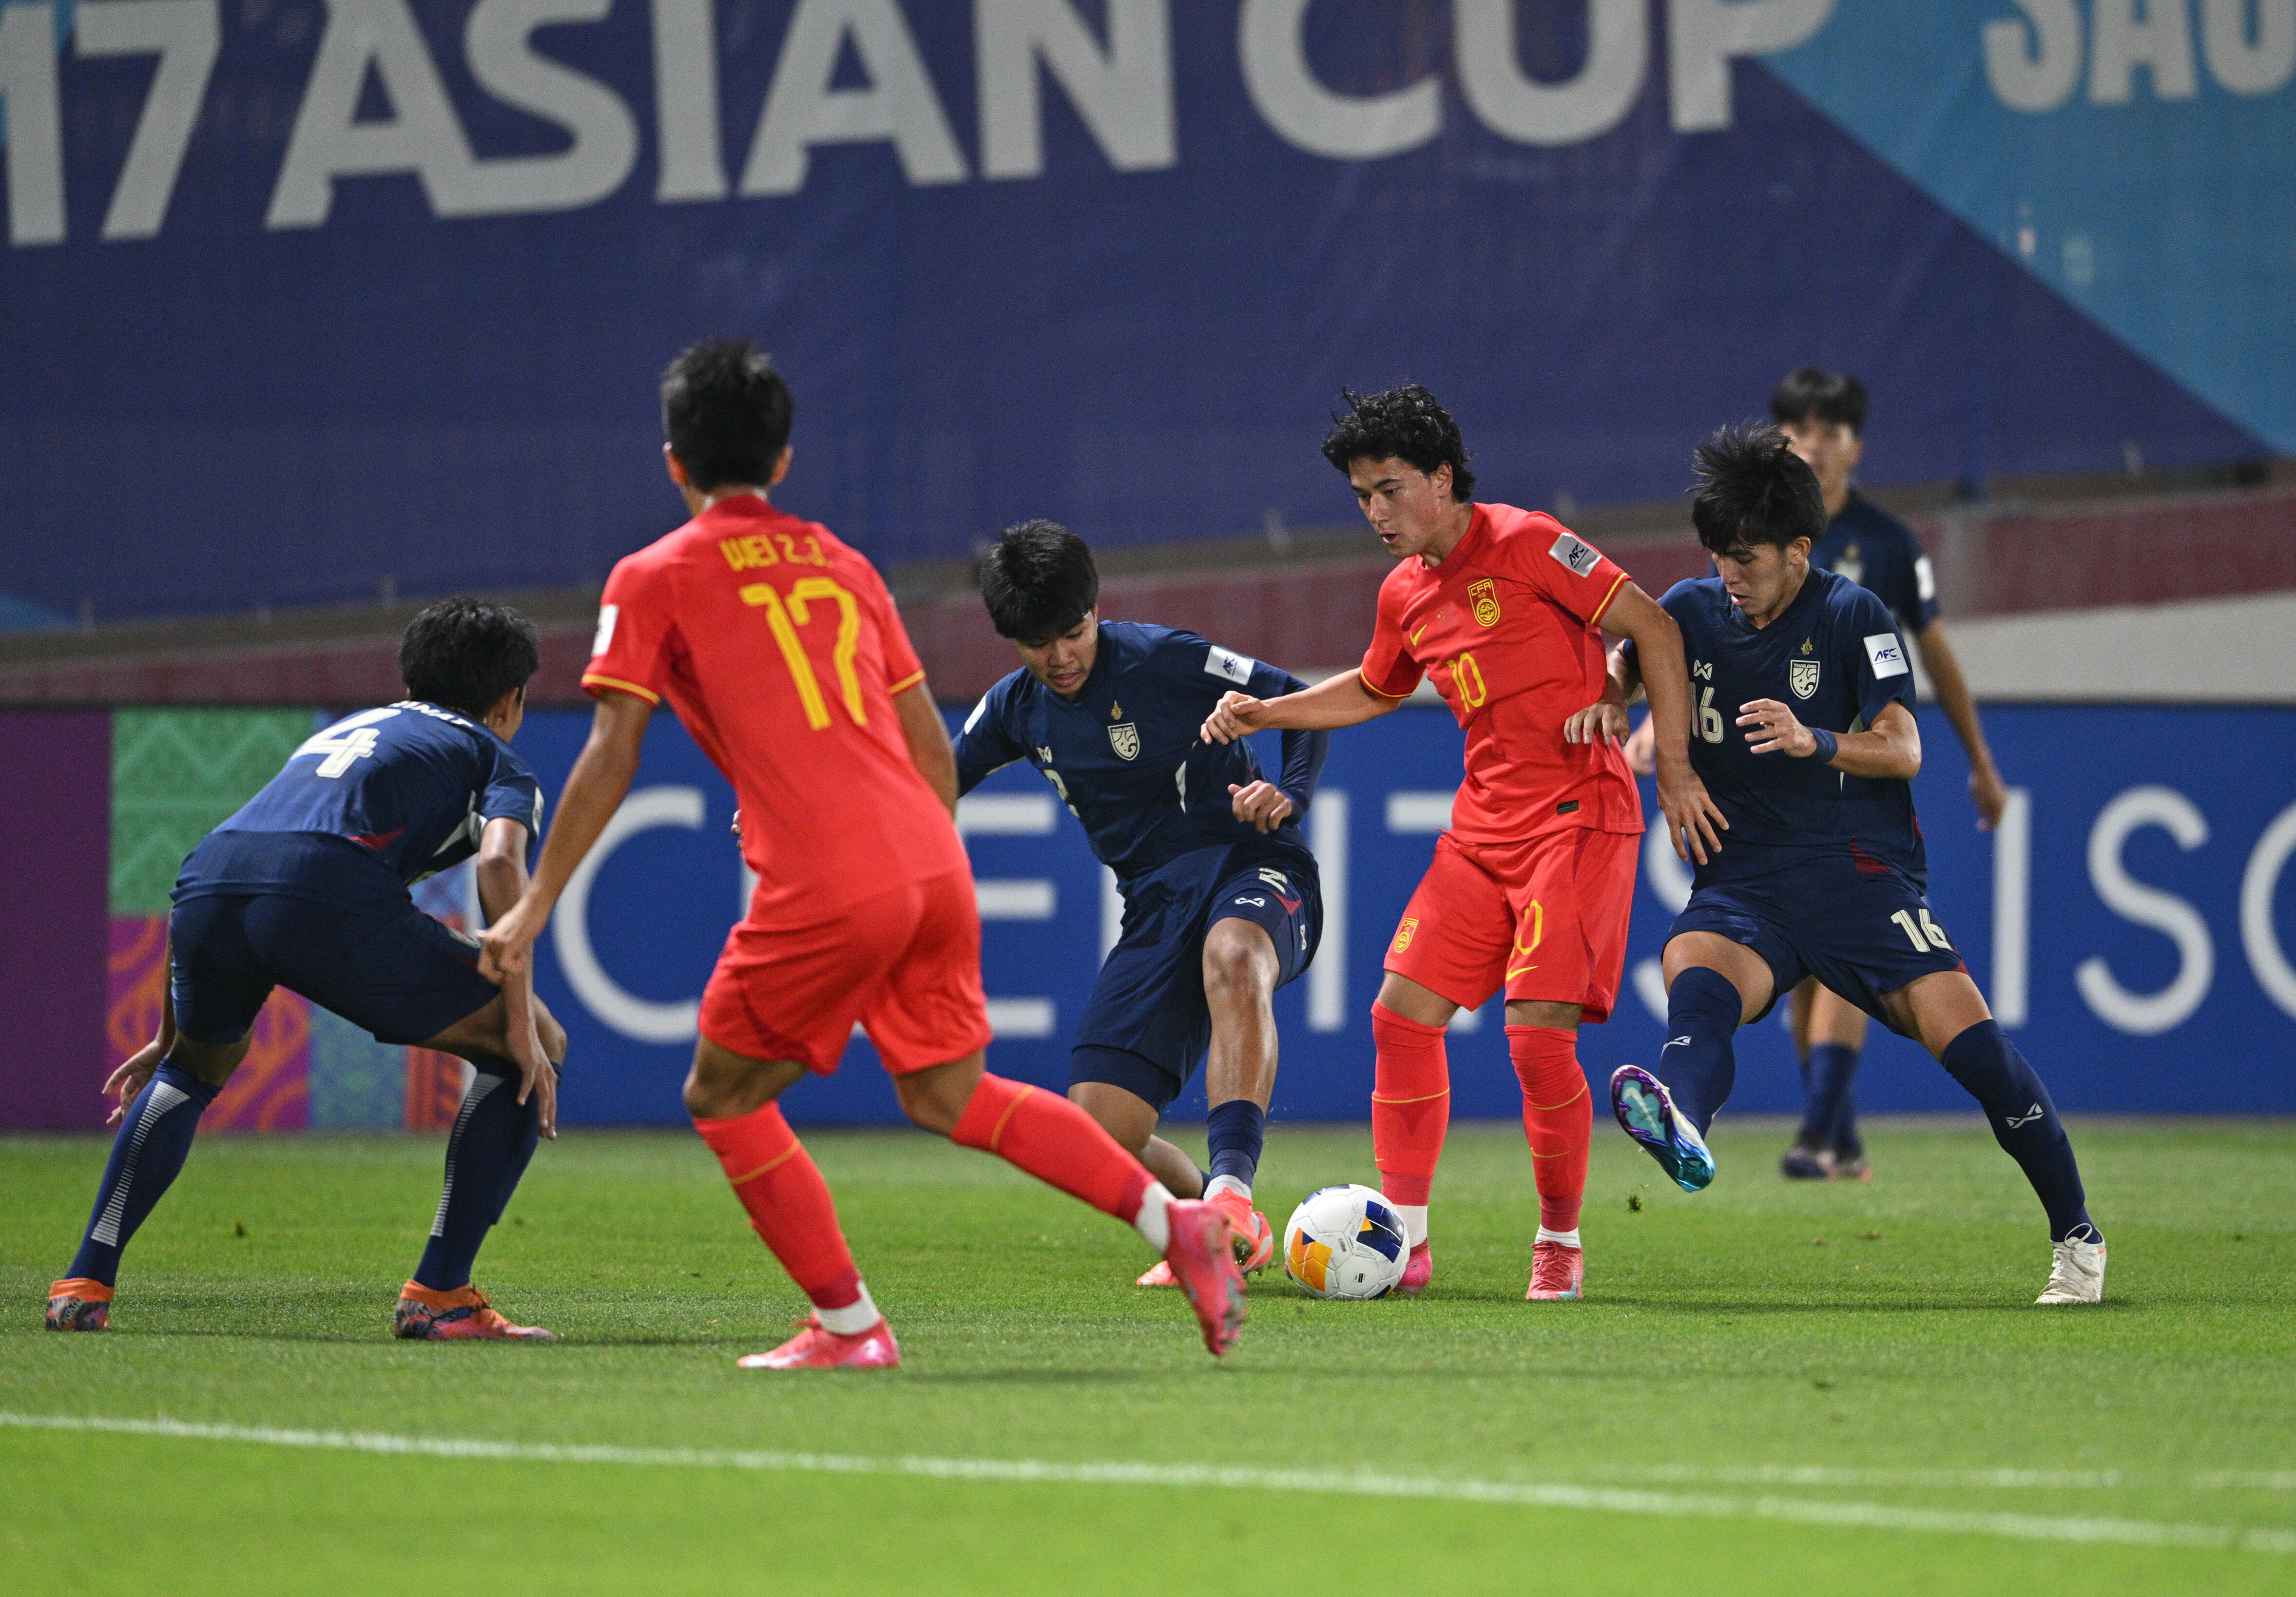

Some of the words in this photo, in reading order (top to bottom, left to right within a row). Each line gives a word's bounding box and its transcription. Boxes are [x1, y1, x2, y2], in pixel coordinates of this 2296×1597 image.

[263, 0, 1177, 231] ASIAN
[1238, 0, 1836, 160] CUP
[1568, 541, 1584, 566] AFC
[1470, 581, 1491, 596] CFA
[739, 577, 868, 731] 17
[1447, 652, 1486, 713] 10
[1874, 648, 1897, 662] AFC
[1690, 681, 1724, 744] 16
[290, 708, 402, 778] 4
[1258, 867, 1288, 894] 2
[1511, 899, 1543, 958] 0
[1891, 908, 1953, 952] 16
